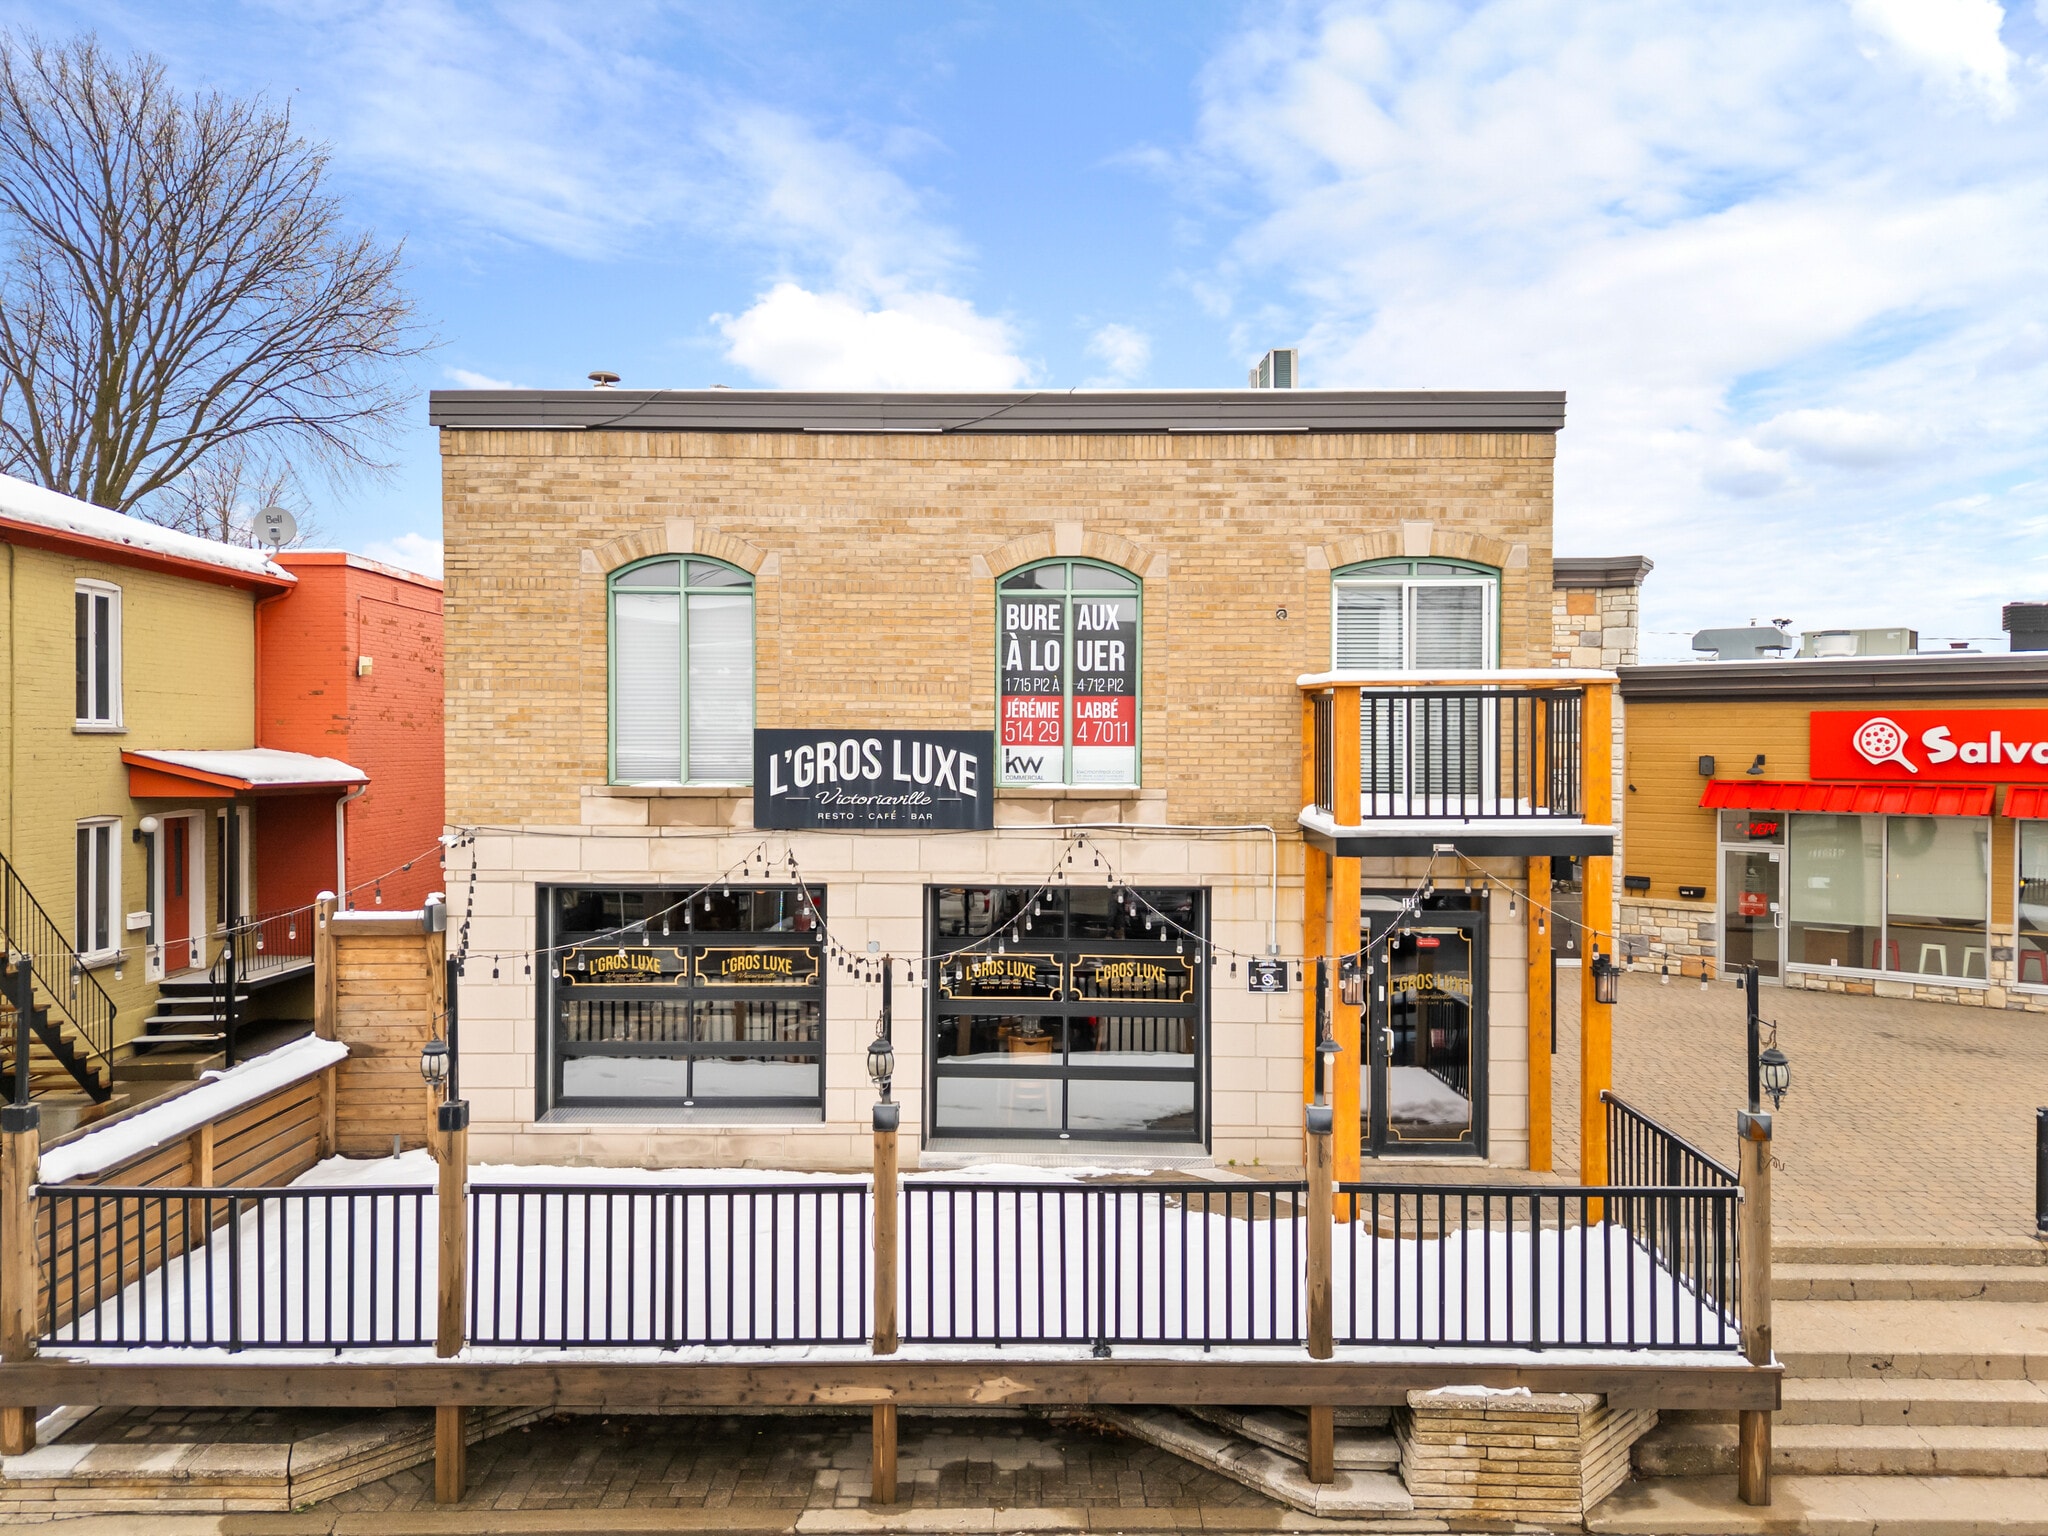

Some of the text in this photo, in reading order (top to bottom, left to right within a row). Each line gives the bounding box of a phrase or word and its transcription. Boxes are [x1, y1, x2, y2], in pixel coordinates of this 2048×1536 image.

[266, 515, 282, 524] Bell
[1006, 604, 1119, 630] BURE AUX
[1006, 632, 1125, 671] À LO UER
[1033, 678, 1050, 692] PI2
[1107, 678, 1124, 692] PI2
[1005, 698, 1118, 718] JÉRÉMIE LABBÉ
[1005, 720, 1128, 742] 514 29 4 7011
[770, 738, 977, 798] L'GROS LUXE
[815, 787, 932, 805] Victoriaville
[868, 810, 897, 820] CAFÉ
[590, 954, 661, 975] L'GROS LUXE
[721, 954, 793, 975] L'GROS LUXE
[966, 960, 1036, 981] LGROS LUXE
[1137, 962, 1166, 983] LUXE
[1437, 973, 1470, 996] LUXE
